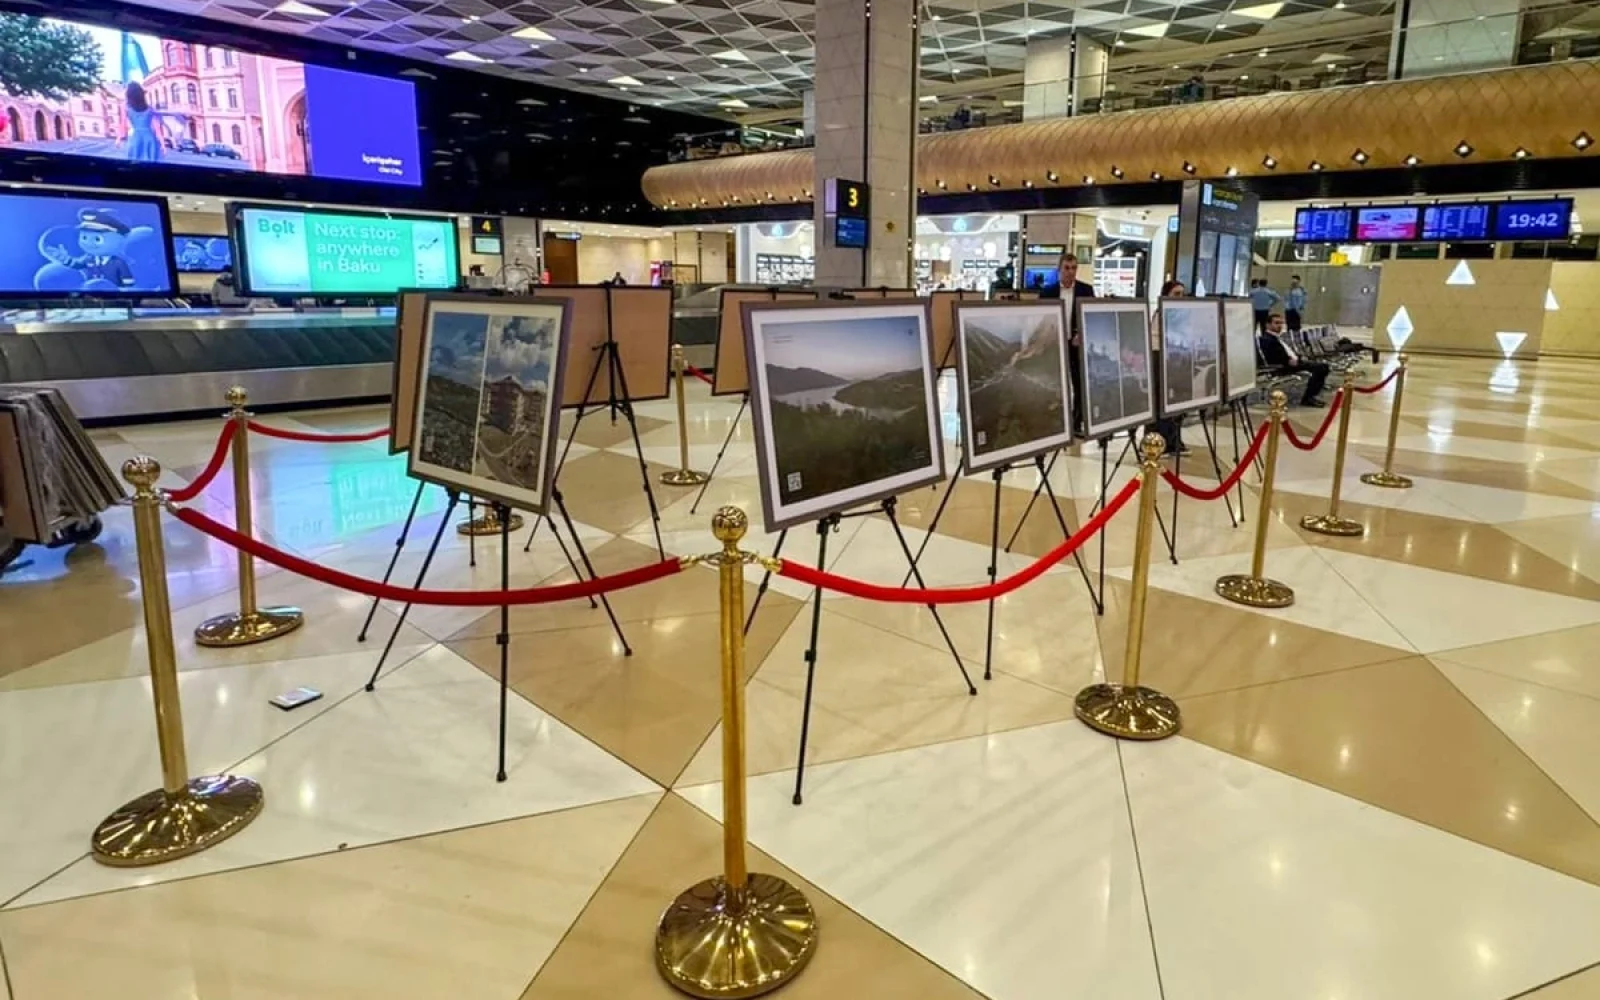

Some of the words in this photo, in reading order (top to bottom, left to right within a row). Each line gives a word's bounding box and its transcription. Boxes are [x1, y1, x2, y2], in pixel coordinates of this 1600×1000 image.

[848, 188, 858, 207] 3
[258, 218, 295, 237] Bolt
[481, 219, 491, 232] 4
[1508, 212, 1558, 228] 19:42
[315, 223, 356, 238] Next
[360, 225, 400, 241] stop:
[316, 242, 400, 258] anywhere
[318, 259, 334, 272] in
[338, 258, 381, 273] Baku
